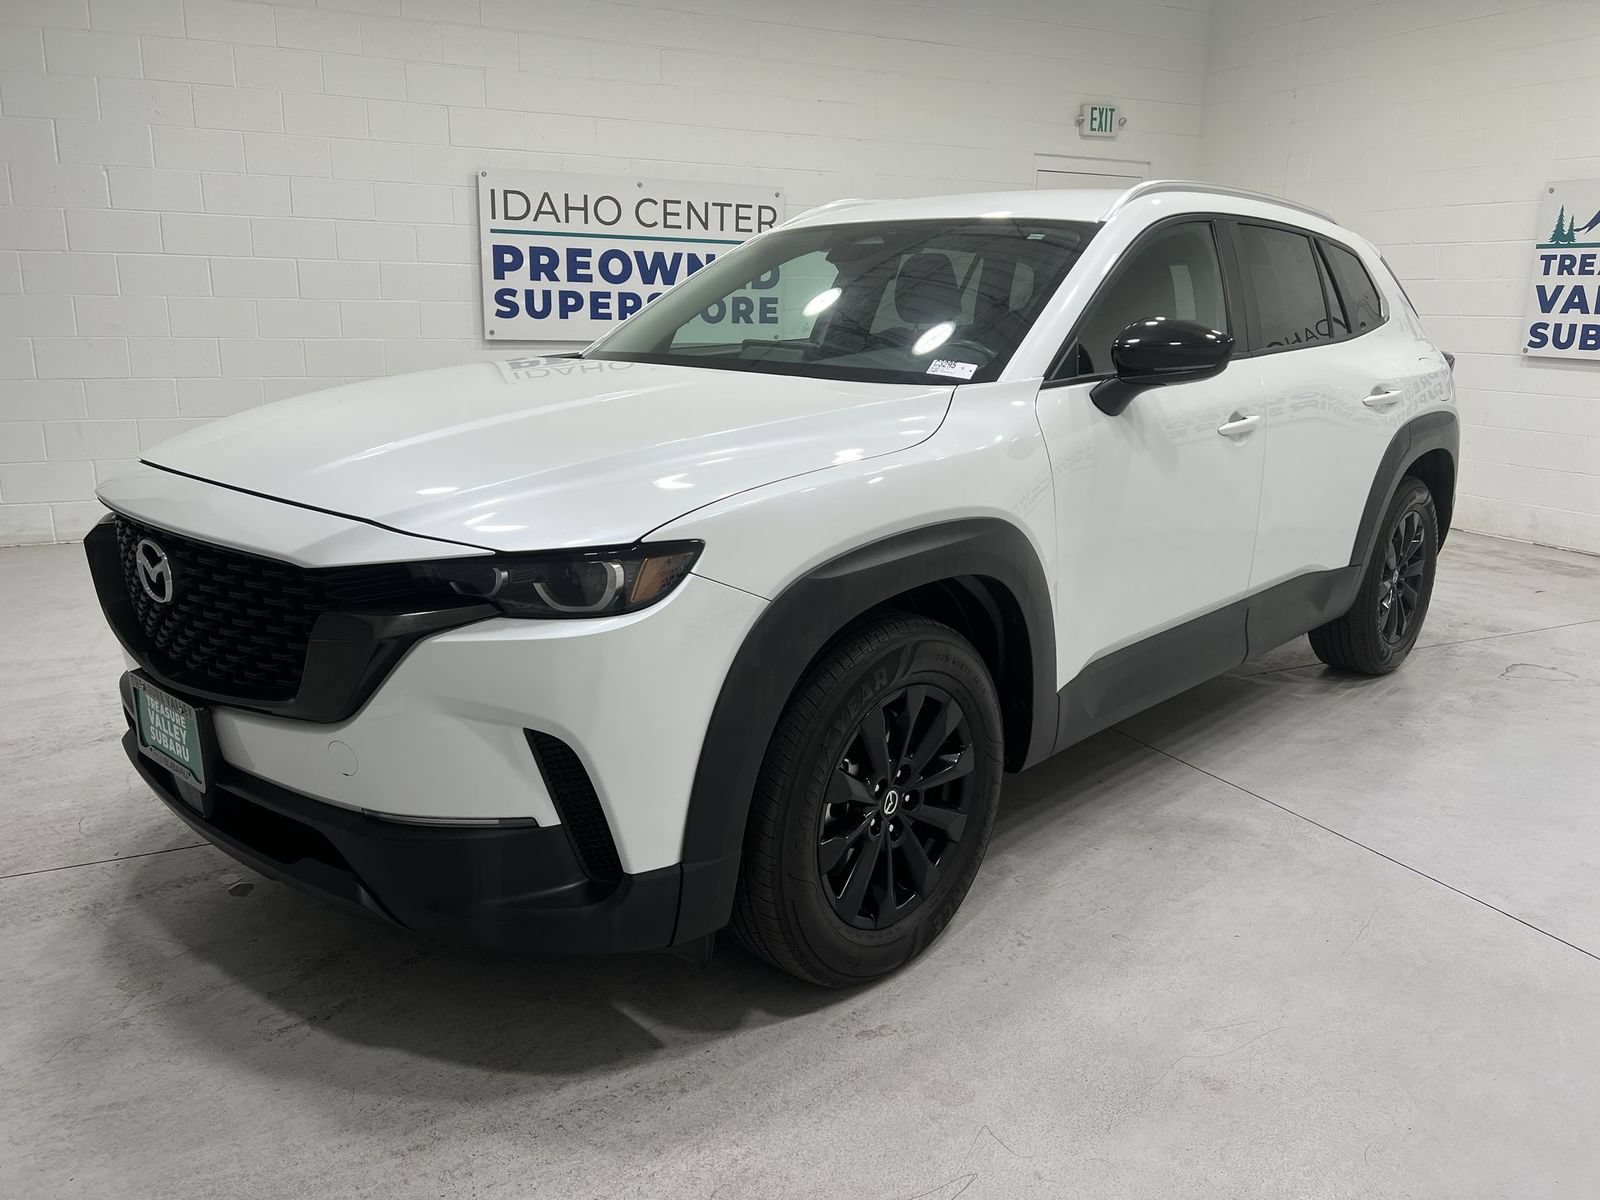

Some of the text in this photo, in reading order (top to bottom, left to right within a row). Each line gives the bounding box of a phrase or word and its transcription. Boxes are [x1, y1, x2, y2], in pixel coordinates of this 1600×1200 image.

[1090, 106, 1116, 133] EXIT
[489, 188, 778, 234] IDAHO CENTER
[492, 244, 780, 290] PREOWND
[1540, 253, 1600, 276] TRE
[494, 287, 779, 325] SUPERORE
[145, 695, 187, 729] TREASURE
[147, 707, 187, 746] VALLEY
[150, 725, 190, 763] SUBARU
